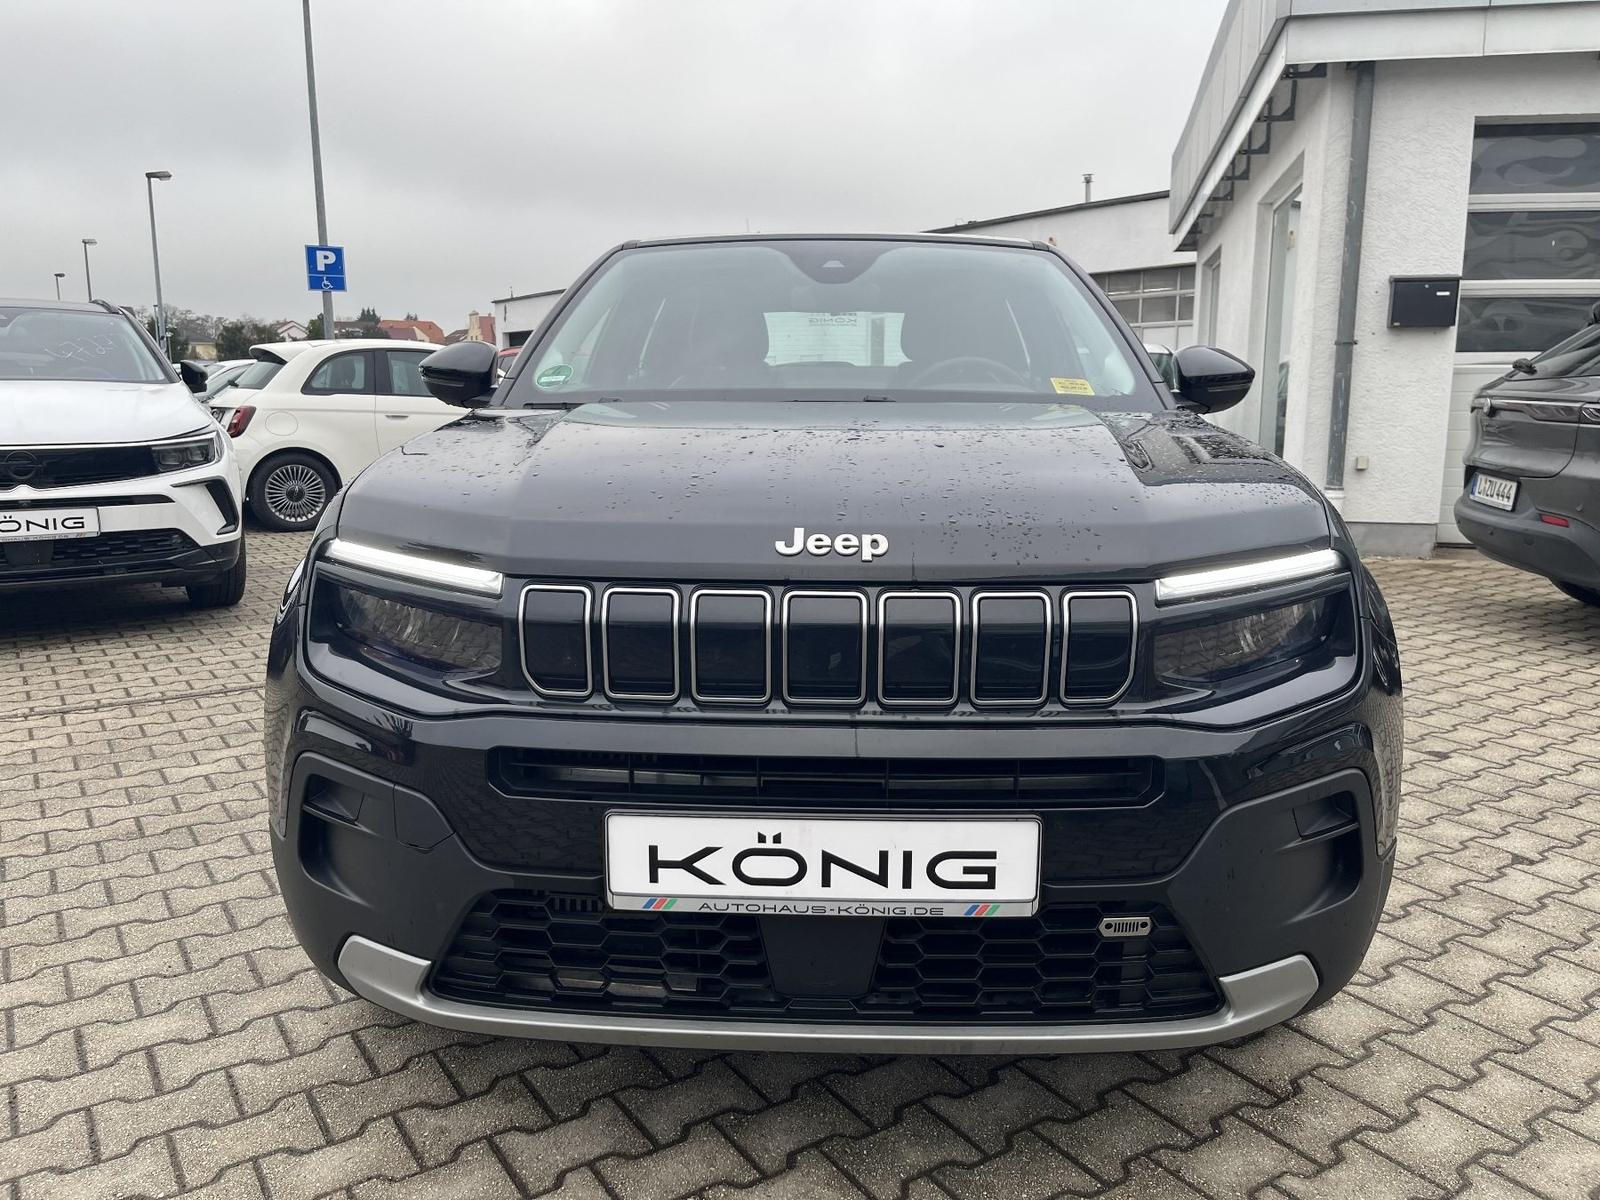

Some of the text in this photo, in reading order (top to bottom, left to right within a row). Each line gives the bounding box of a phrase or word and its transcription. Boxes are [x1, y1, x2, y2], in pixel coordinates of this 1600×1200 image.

[316, 250, 337, 272] P
[775, 527, 889, 562] Jeep
[648, 831, 998, 890] KÖNIG
[698, 902, 944, 917] AUTOHAUS-KÖNIG.DE
